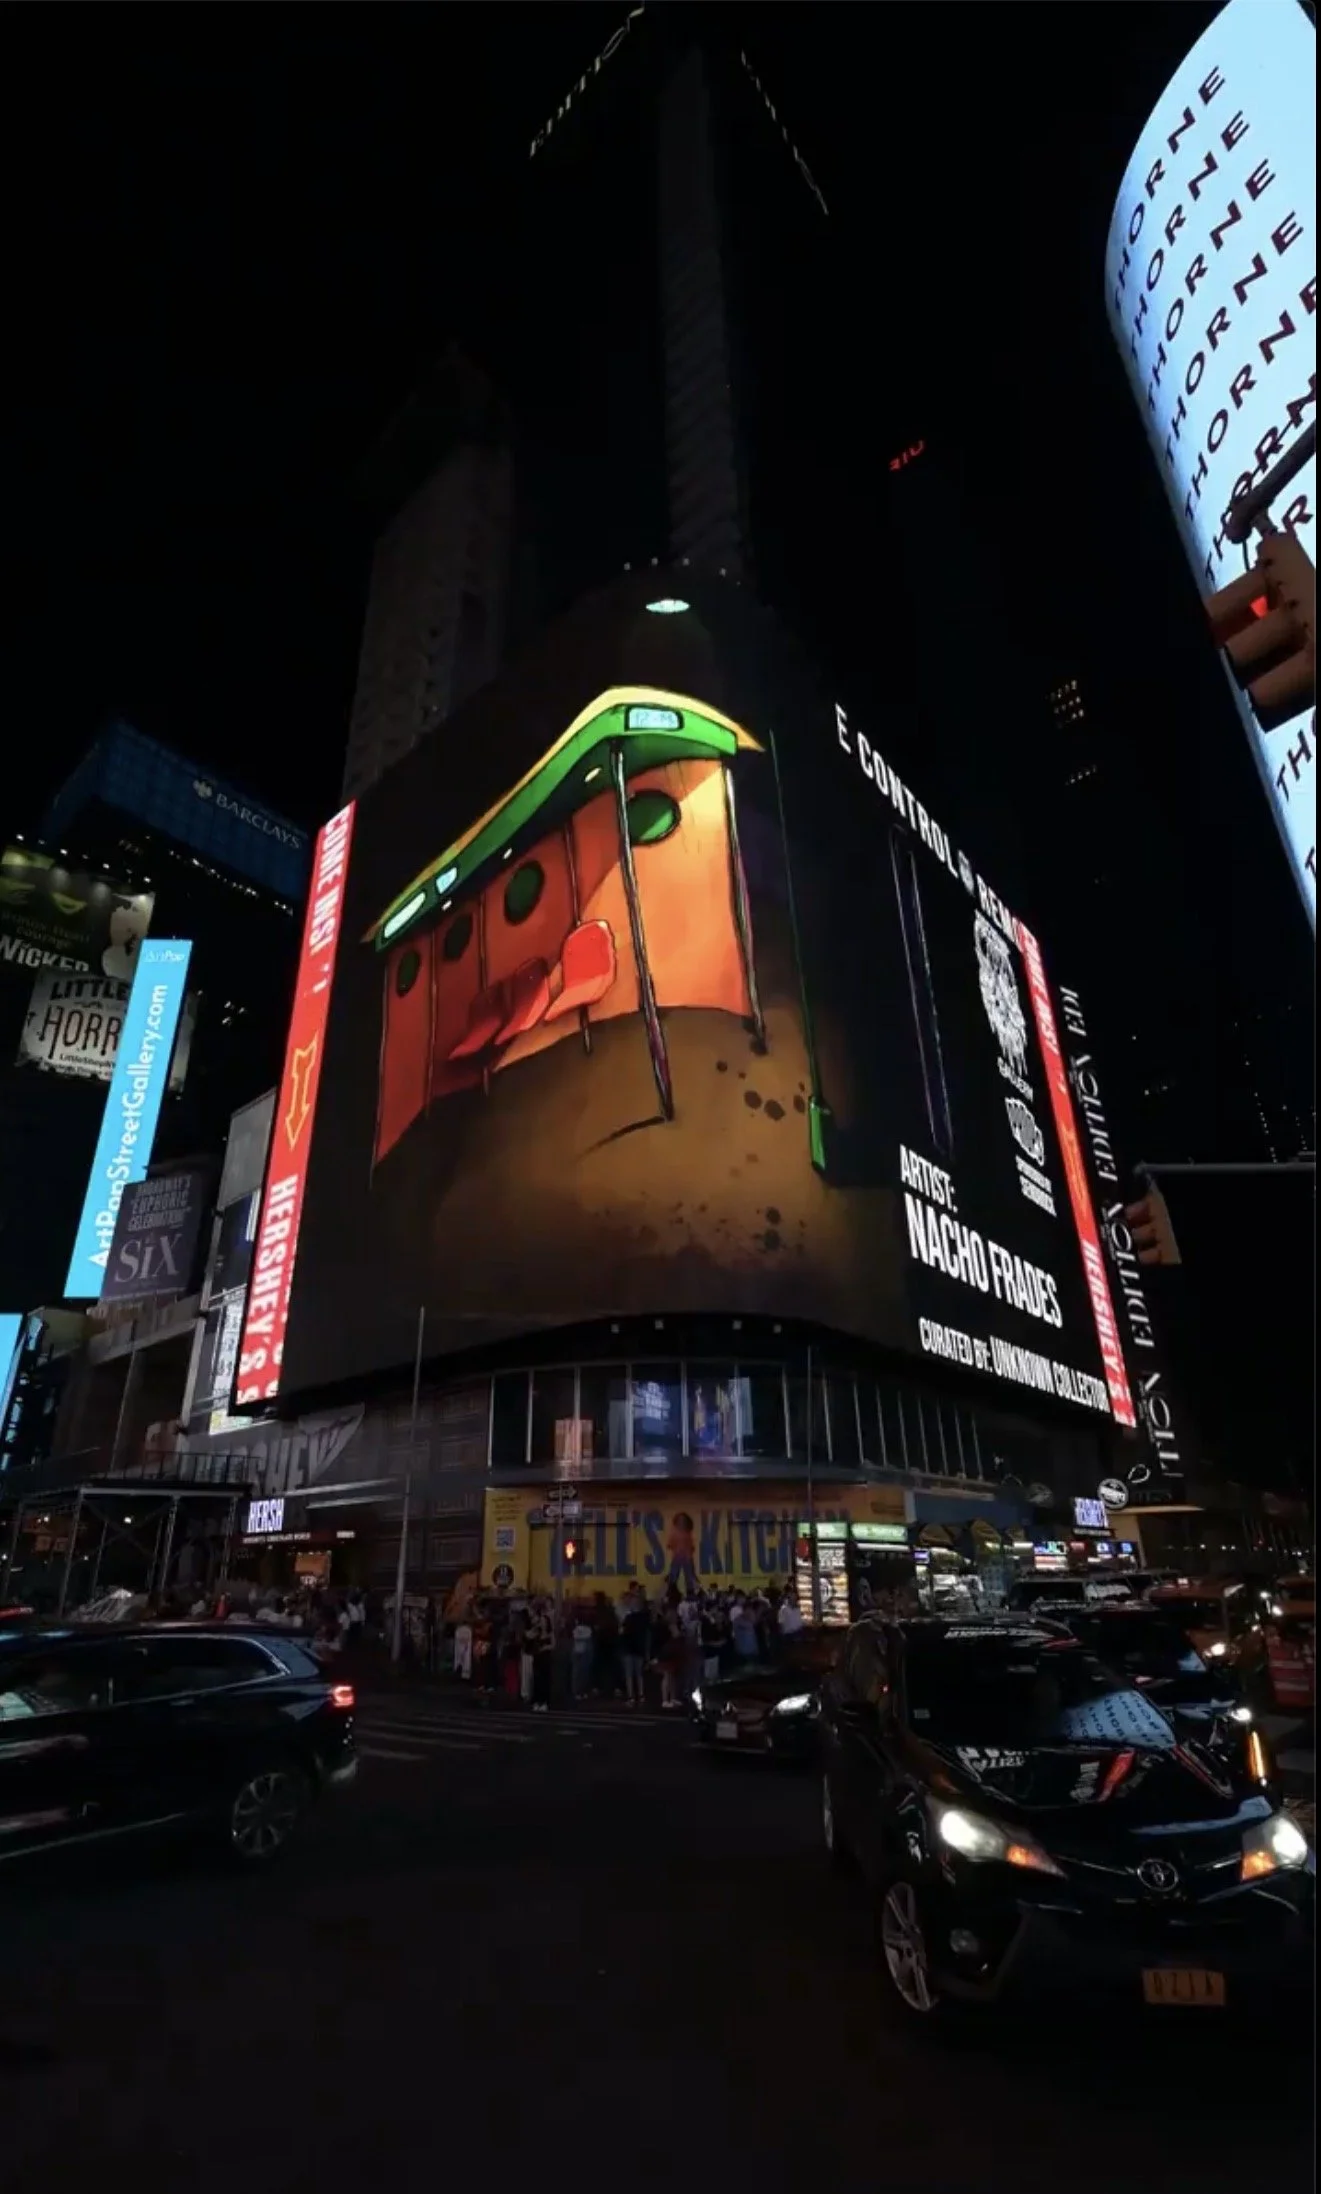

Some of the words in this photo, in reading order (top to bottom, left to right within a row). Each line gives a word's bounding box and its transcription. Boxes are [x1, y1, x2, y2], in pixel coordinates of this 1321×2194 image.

[1114, 65, 1226, 313] THORNE
[1130, 109, 1250, 360] THORNE
[1147, 158, 1276, 411] THORNE
[1164, 210, 1305, 464] THORNE
[216, 792, 302, 849] BARCLAYS
[857, 731, 959, 879] CONTROL
[50, 978, 131, 1001] LITTLE
[900, 1143, 958, 1214] ARTIST:
[238, 1173, 299, 1377] HERSHEY'S
[904, 1191, 990, 1294] NACHO
[987, 1239, 1064, 1329] FRADES
[1107, 1202, 1155, 1348] EDITION
[918, 1316, 974, 1367] CURATED
[989, 1335, 1056, 1394] UNKNOWN
